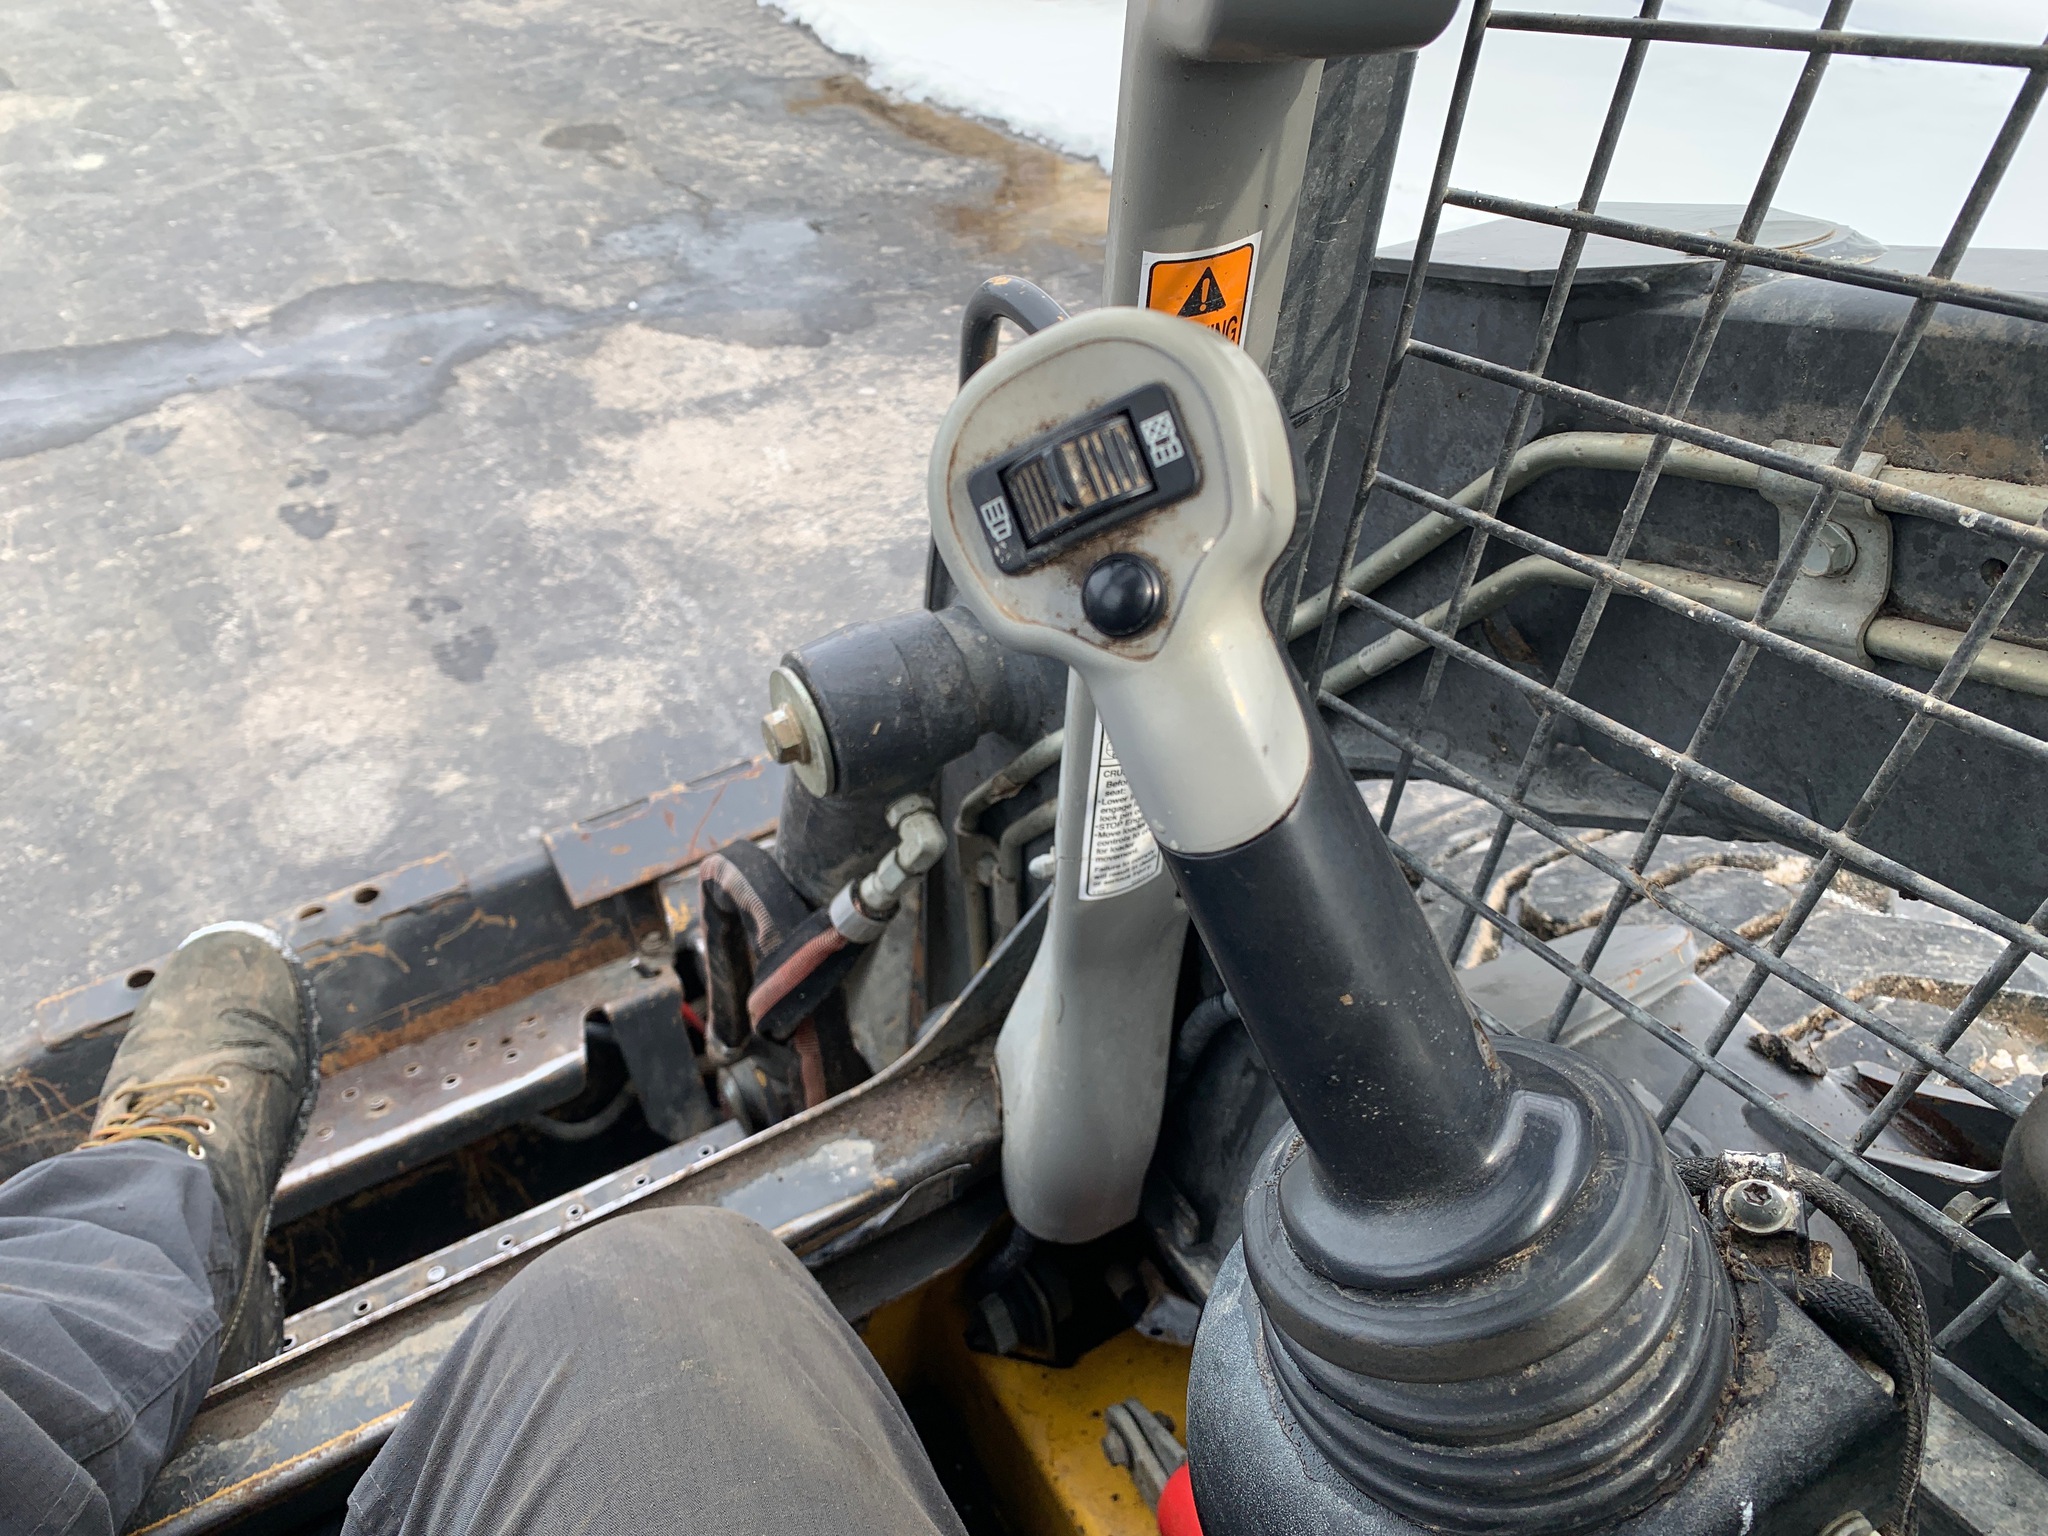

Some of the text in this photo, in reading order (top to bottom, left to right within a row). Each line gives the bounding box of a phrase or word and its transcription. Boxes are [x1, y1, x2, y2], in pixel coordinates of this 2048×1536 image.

[1103, 769, 1125, 778] CRU
[1102, 796, 1129, 806] Lower
[1099, 820, 1123, 831] STOP
